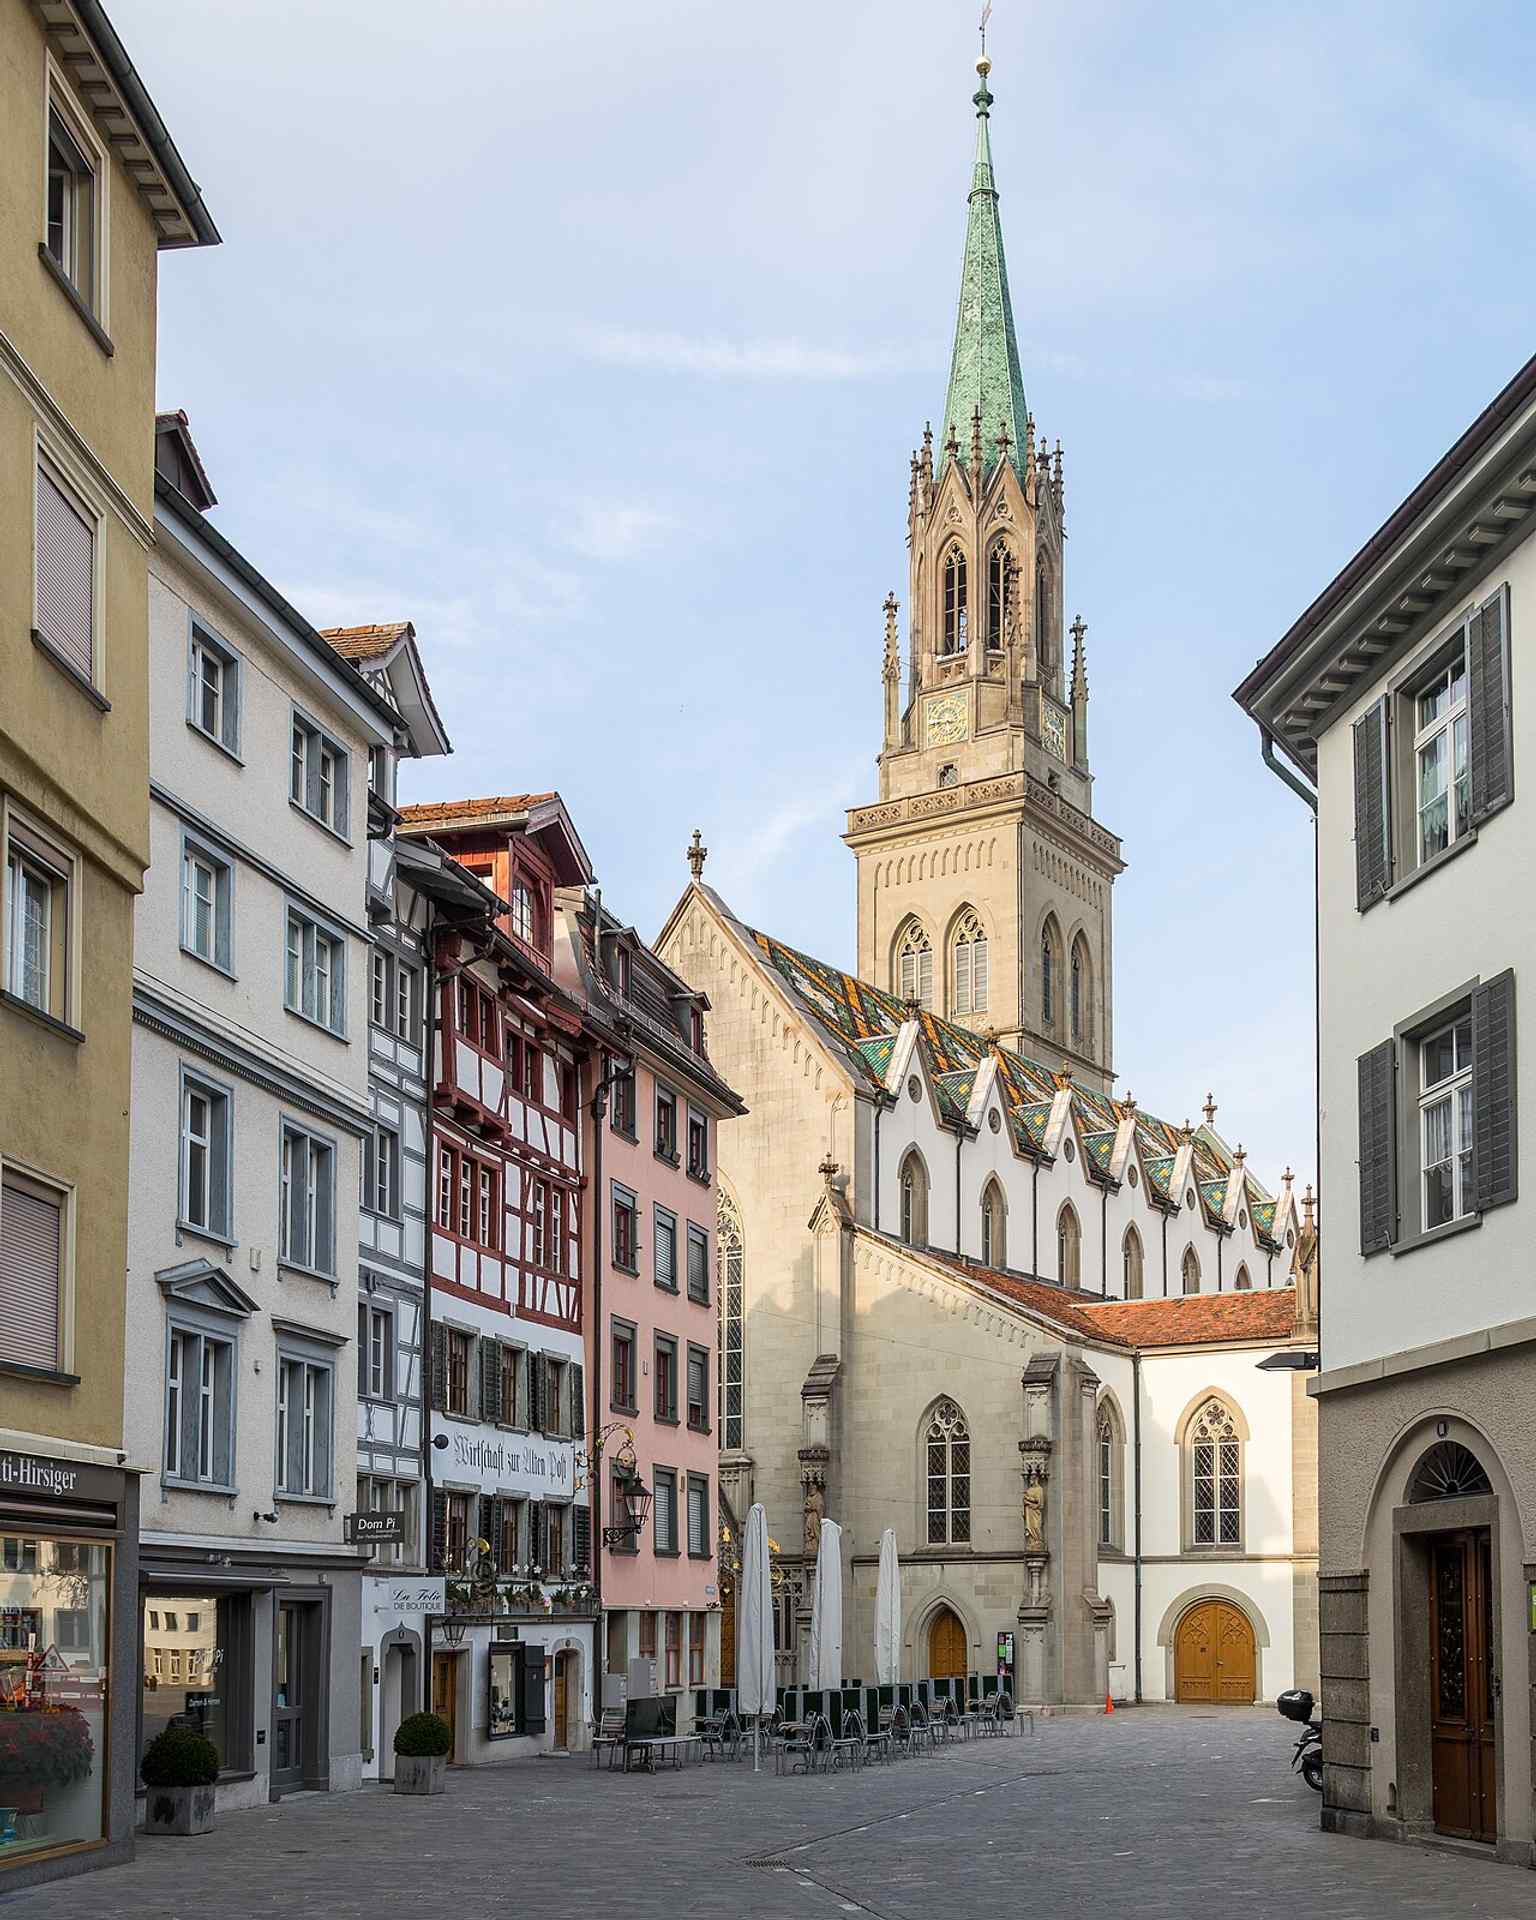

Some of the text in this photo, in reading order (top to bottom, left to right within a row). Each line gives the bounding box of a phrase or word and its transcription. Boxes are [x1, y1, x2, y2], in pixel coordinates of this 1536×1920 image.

[453, 1432, 567, 1485] Wirtschaft zur Alten Post
[0, 1456, 77, 1496] ti-Hirsiger
[358, 1517, 396, 1530] Dom Pi
[406, 1602, 443, 1611] BOUTIQUE
